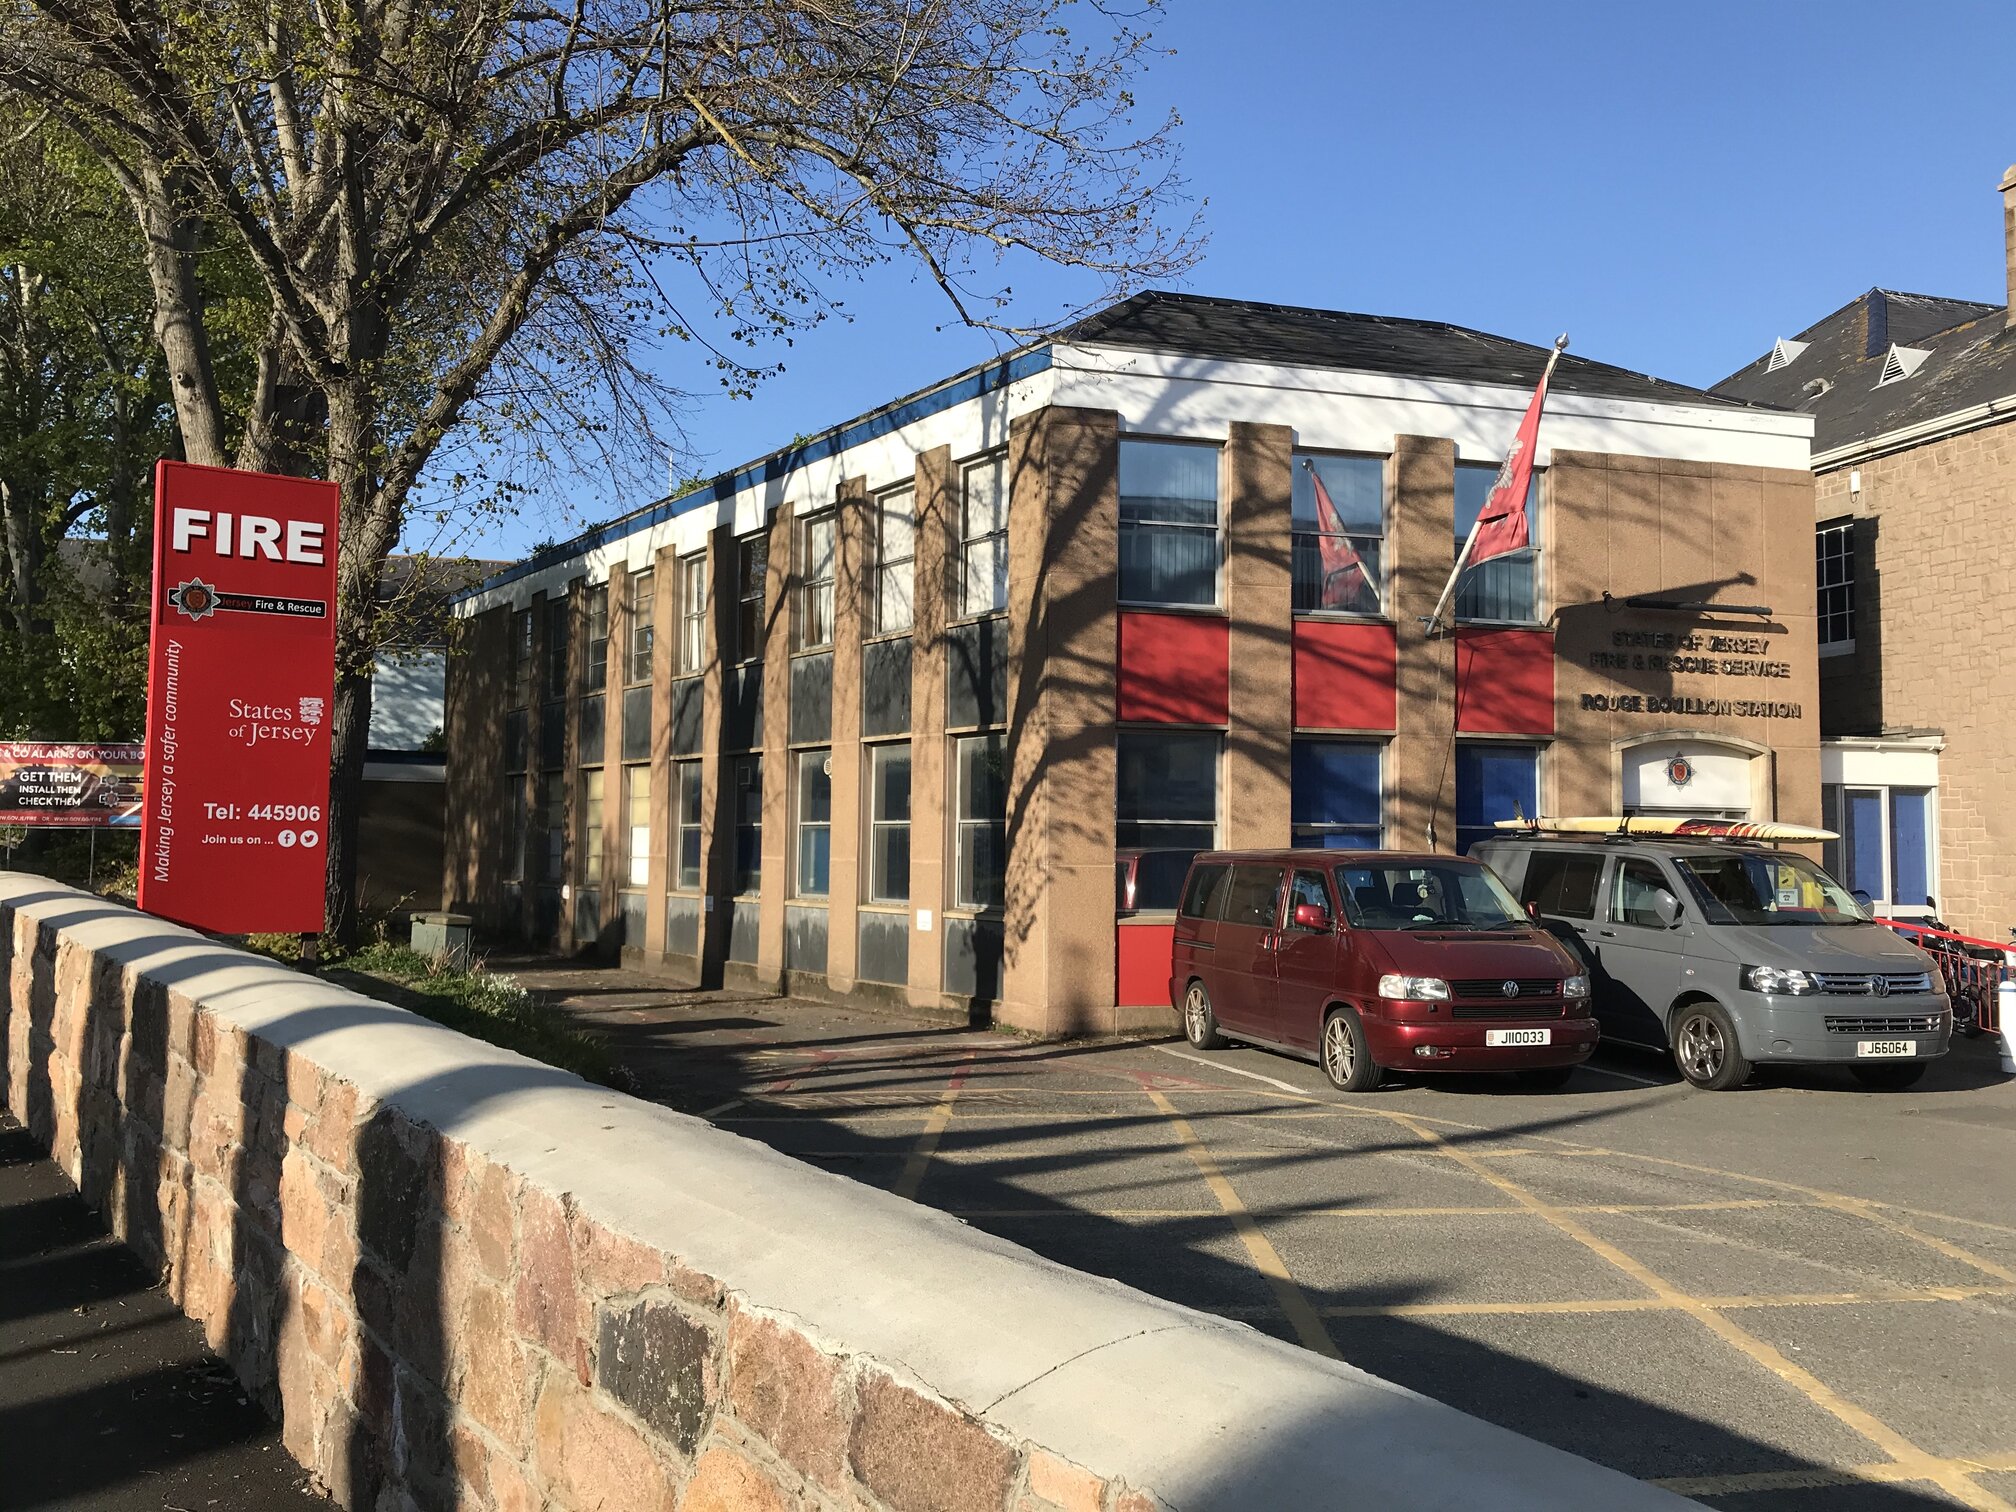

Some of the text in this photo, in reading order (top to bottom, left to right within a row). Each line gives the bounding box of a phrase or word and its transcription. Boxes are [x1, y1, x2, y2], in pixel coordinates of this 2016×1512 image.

[172, 507, 325, 565] FIRE
[221, 597, 253, 609] Jersey
[255, 599, 275, 610] Fire
[276, 601, 285, 611] &
[287, 602, 322, 614] Rescue
[1612, 631, 1769, 655] STATES OF JERSEY
[1590, 652, 1790, 678] FIRE & RESCUE SERVICE
[228, 698, 292, 721] States
[1581, 693, 1802, 719] ROUGE BOUILLON STATION
[228, 722, 317, 747] of Jersey
[13, 750, 29, 759] CO
[31, 750, 75, 759] ALARMS
[77, 750, 95, 759] ON
[98, 751, 128, 760] YOUR
[154, 639, 183, 883] Making Jersey a safer community
[20, 771, 82, 783] GET THEM
[19, 785, 81, 794] INSTALL THEM
[18, 797, 81, 806] CHECK THEM
[203, 802, 321, 822] Tel: 445906
[201, 834, 227, 845] Join
[230, 836, 244, 845] us
[246, 836, 261, 845] on
[1867, 1042, 1908, 1054] J66064
